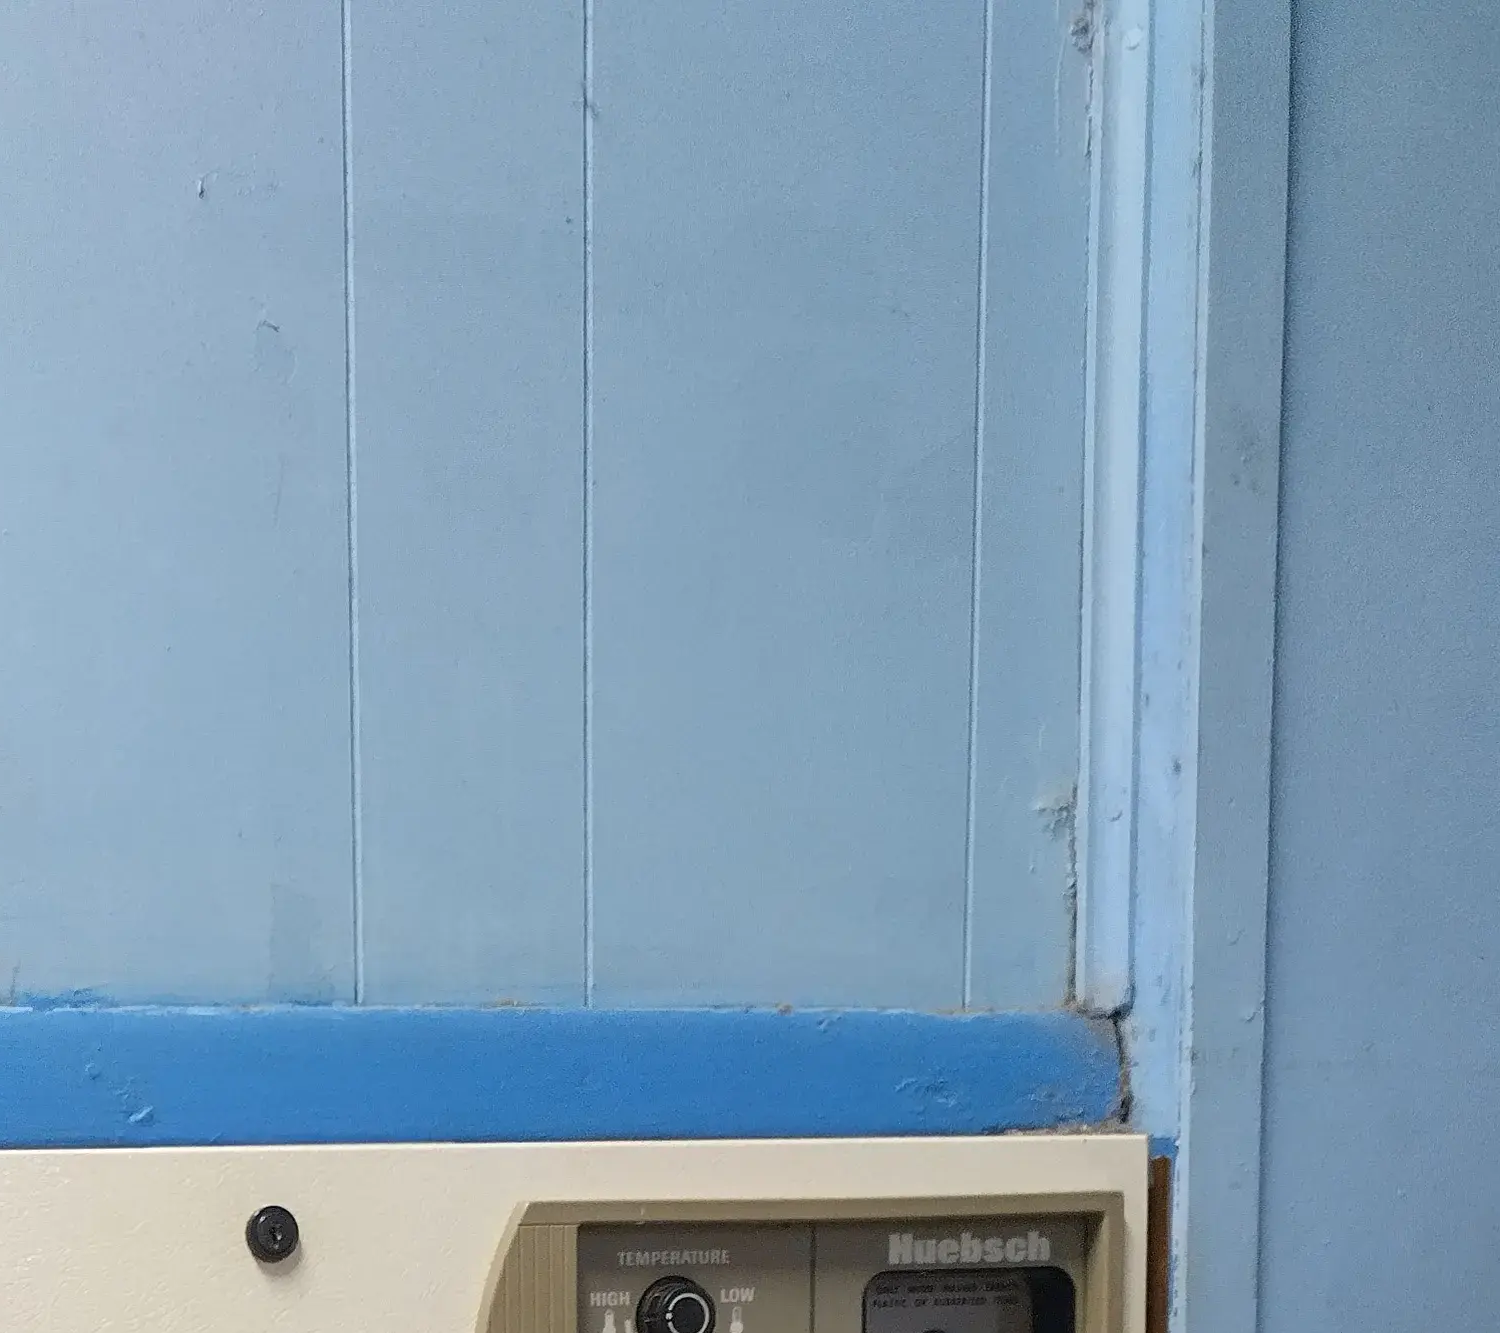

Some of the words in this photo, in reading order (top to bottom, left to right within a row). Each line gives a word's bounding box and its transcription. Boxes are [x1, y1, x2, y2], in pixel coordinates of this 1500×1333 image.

[887, 1230, 1051, 1265] Huebsch
[616, 1249, 731, 1267] TEMPERATURE
[589, 1291, 631, 1307] HIGH
[720, 1287, 756, 1303] LOW
